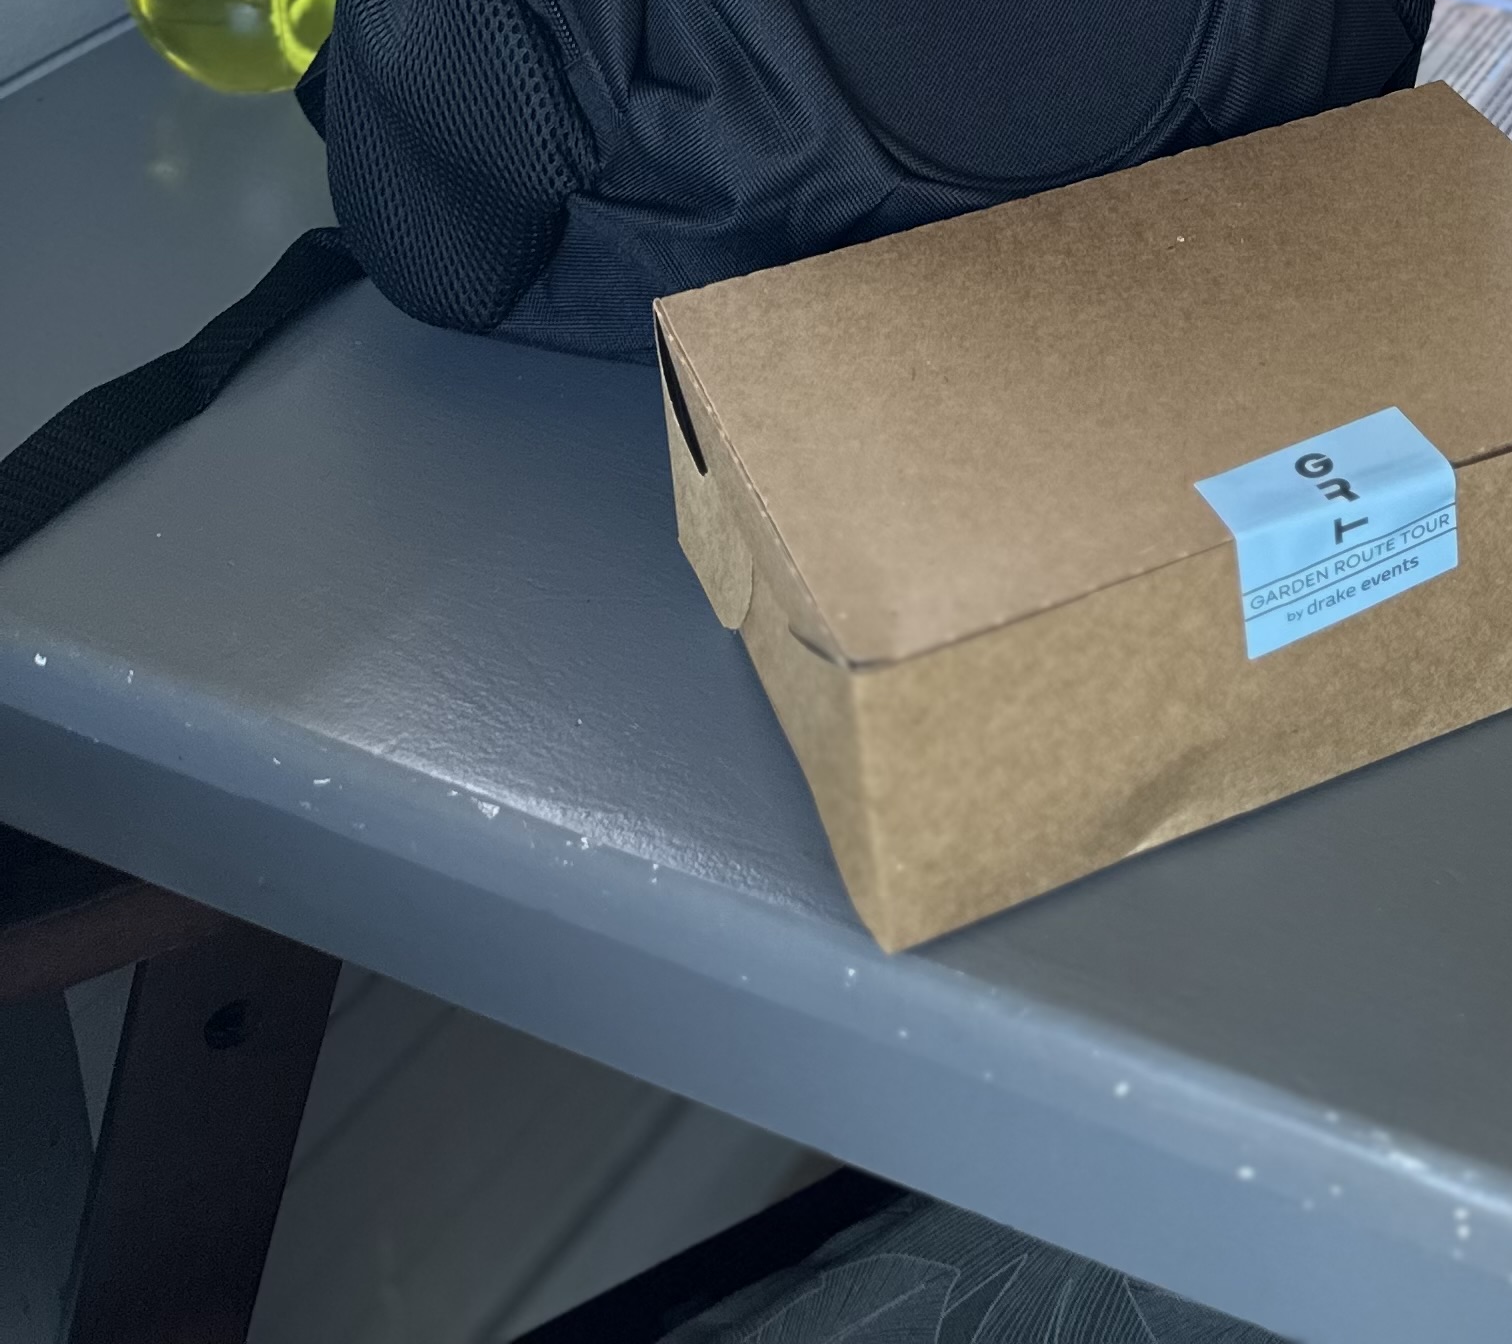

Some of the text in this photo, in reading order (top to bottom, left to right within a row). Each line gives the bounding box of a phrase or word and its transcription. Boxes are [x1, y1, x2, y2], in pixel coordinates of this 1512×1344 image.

[1250, 512, 1451, 611] GARDEN ROUTE TOUR
[1286, 555, 1420, 623] by drake events
